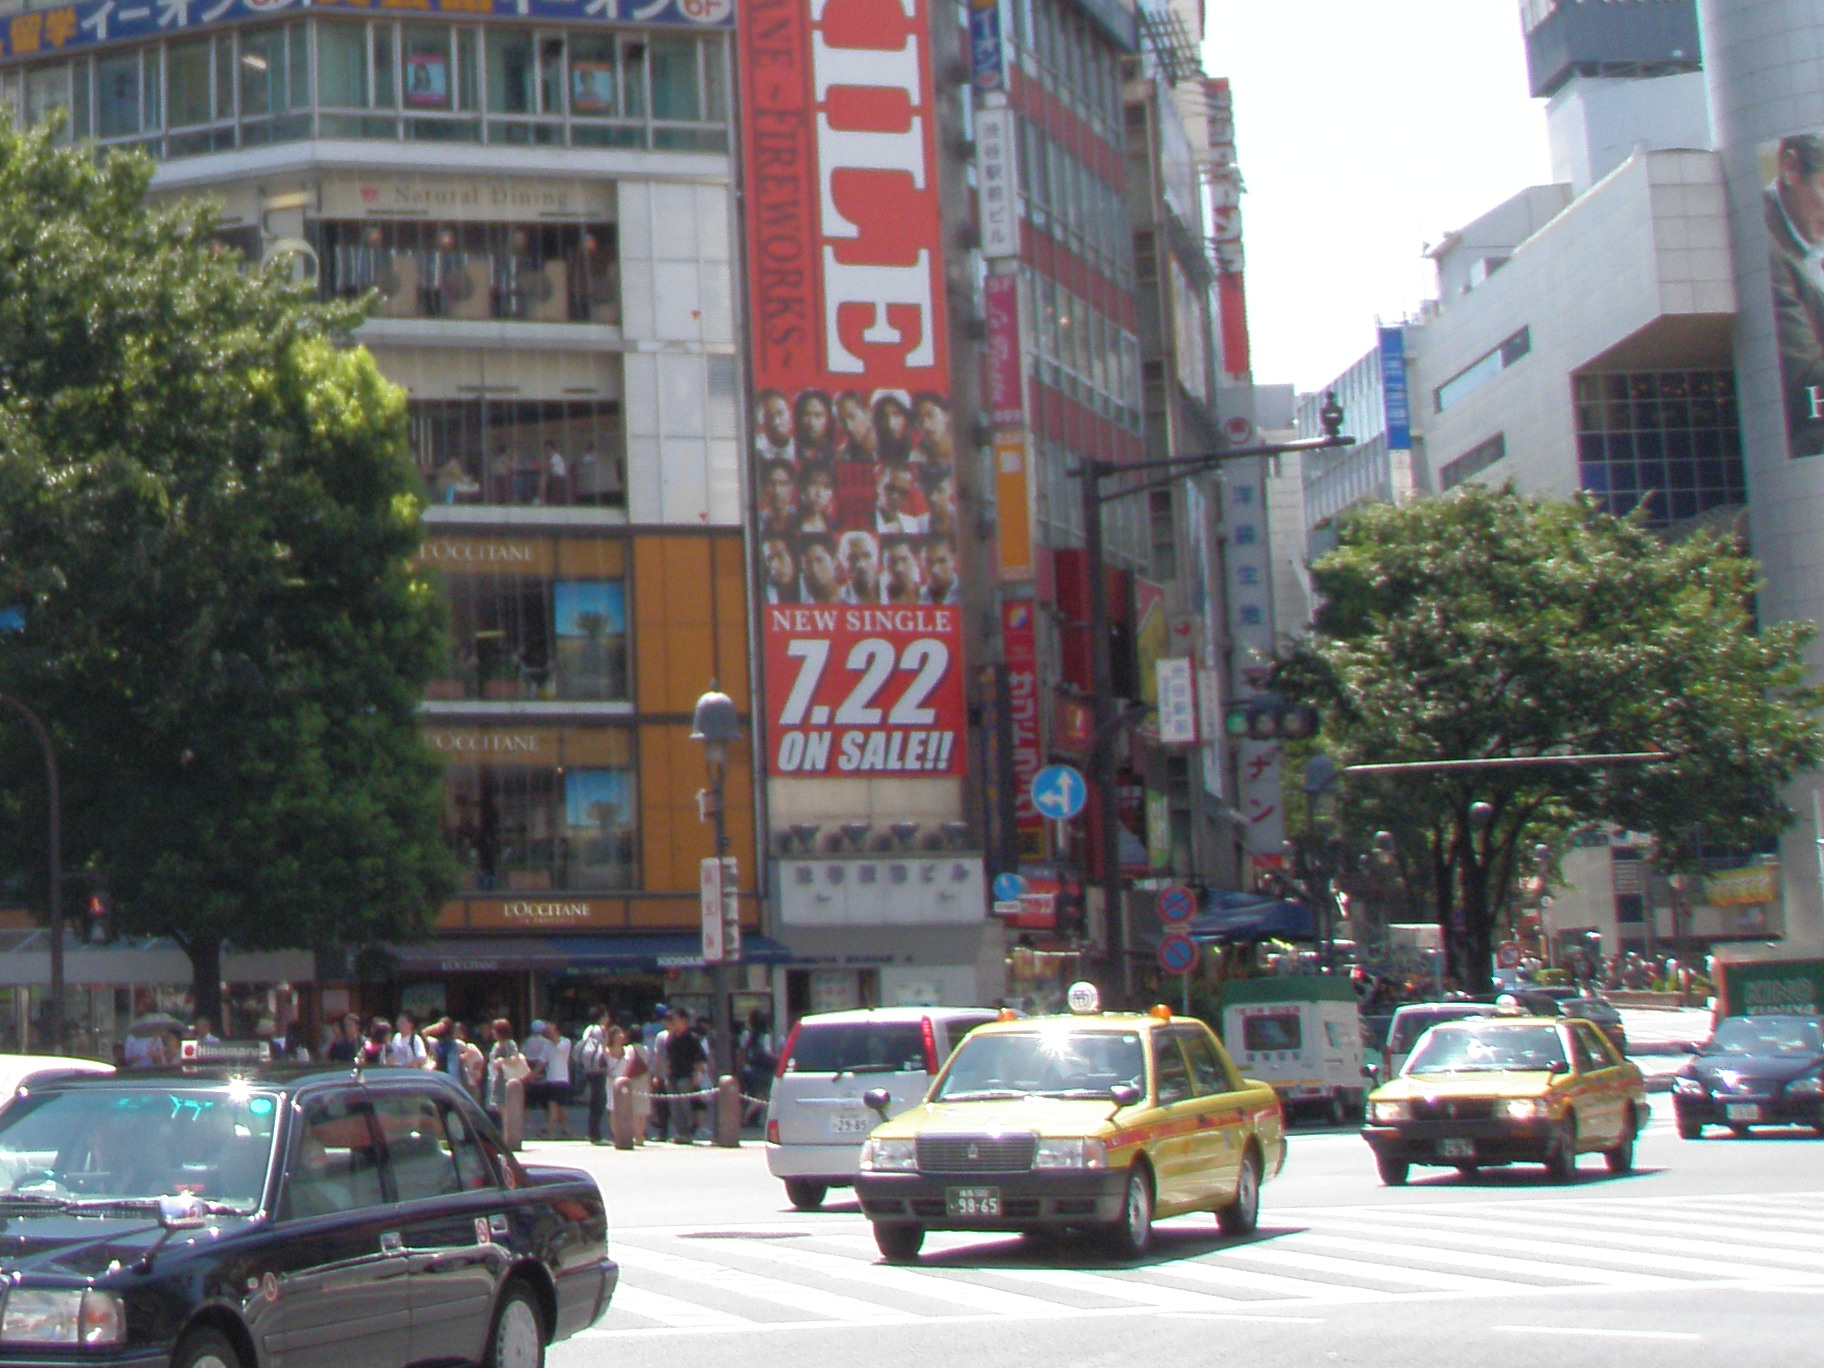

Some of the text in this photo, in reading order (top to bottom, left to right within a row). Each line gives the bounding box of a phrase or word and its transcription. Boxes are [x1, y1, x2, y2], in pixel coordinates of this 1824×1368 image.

[394, 186, 568, 209] Natural Dining
[753, 110, 805, 344] FIREWORKS
[771, 610, 952, 632] NEW SINGLE
[779, 638, 951, 726] 7.22
[777, 730, 954, 773] ON SALE!!
[504, 903, 590, 917] L'OCCITANE
[198, 1045, 259, 1056] Hinomaru
[959, 1198, 998, 1213] 98-65
